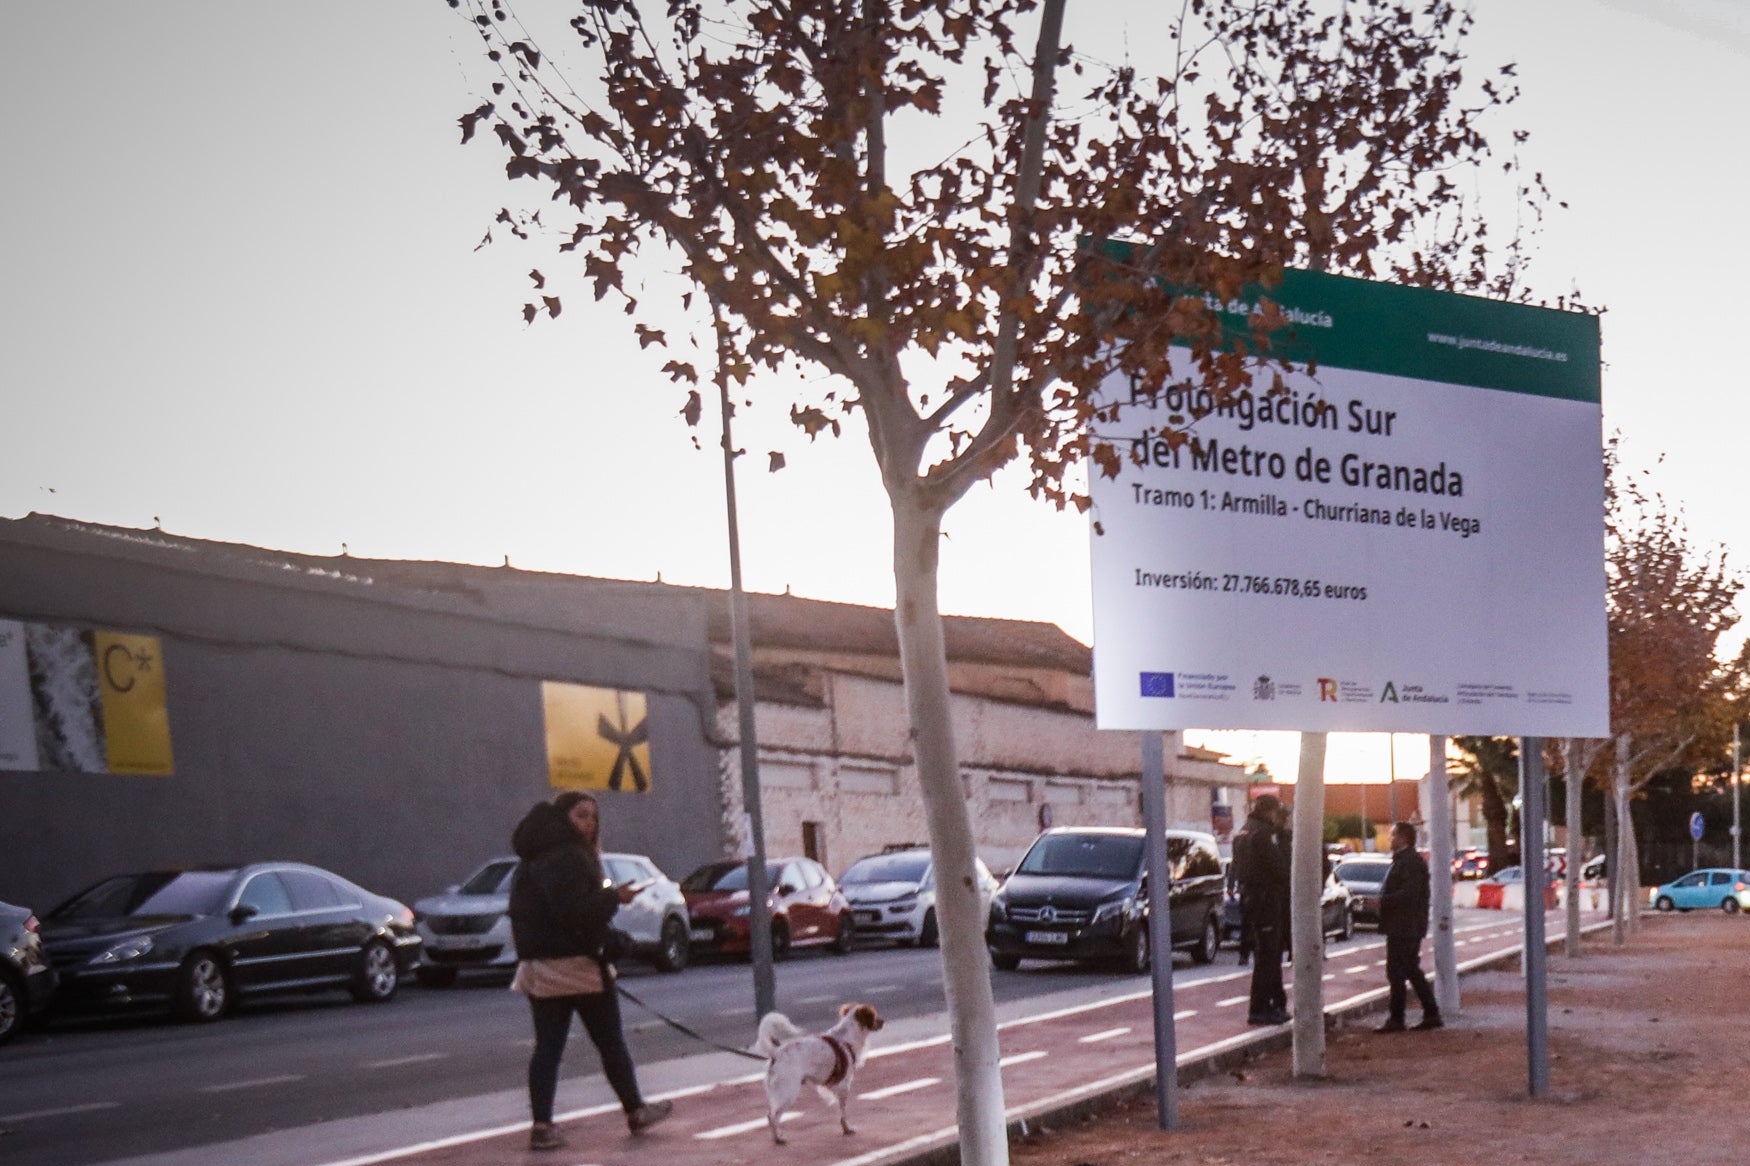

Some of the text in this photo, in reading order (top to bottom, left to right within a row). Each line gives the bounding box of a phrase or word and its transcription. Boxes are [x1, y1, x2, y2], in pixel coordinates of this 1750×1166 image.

[1253, 302, 1333, 329] Aalucía
[1347, 399, 1397, 438] Sur
[1131, 429, 1464, 498] del Metro de Granada
[1131, 483, 1195, 509] Tramo
[1201, 489, 1216, 511] 1:
[1221, 491, 1288, 516] Armilla
[1303, 499, 1391, 526] Churriana
[1396, 506, 1417, 527] de
[1421, 508, 1436, 529] la
[1440, 511, 1481, 538] Vega
[1135, 568, 1367, 600] Inversión: 27.766.678,65 euros
